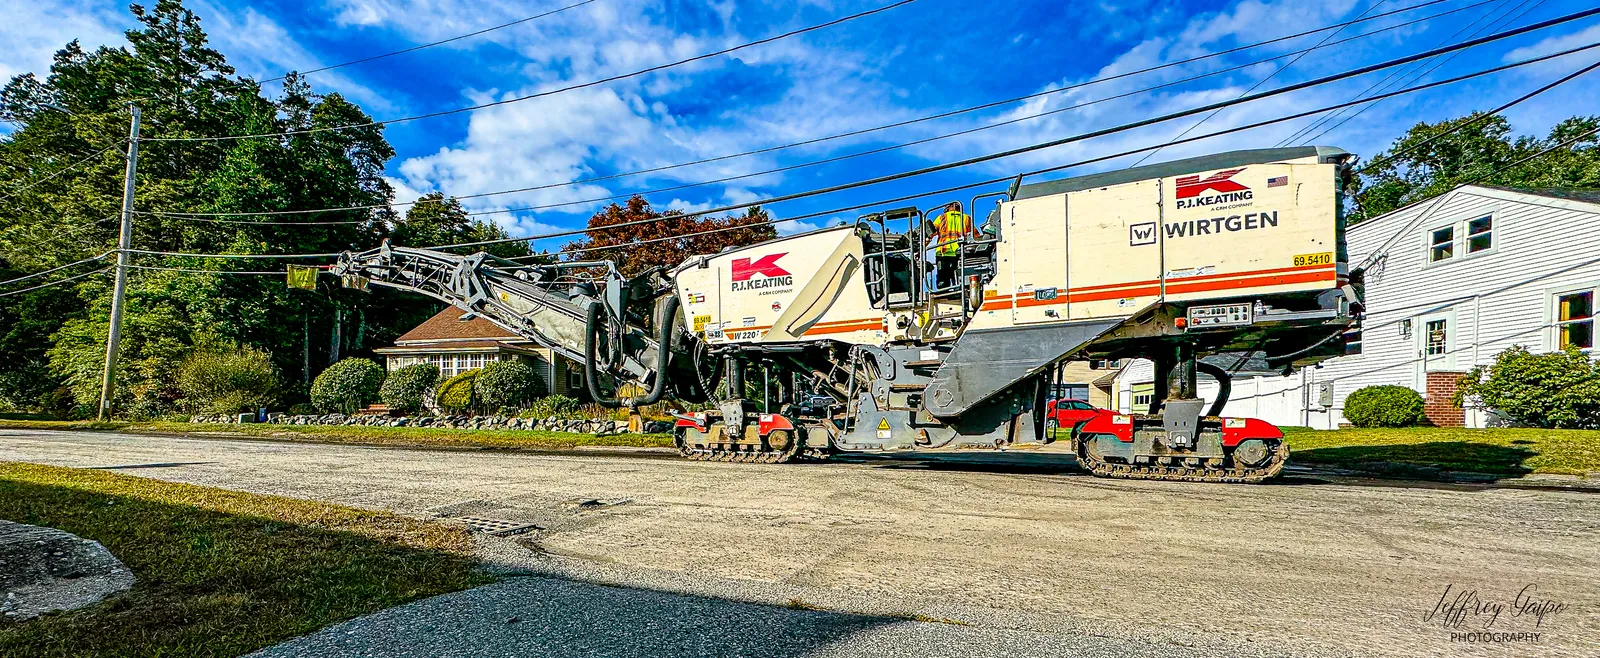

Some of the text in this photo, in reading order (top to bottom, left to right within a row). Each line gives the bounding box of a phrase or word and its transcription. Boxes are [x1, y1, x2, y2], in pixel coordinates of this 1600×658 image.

[1176, 191, 1253, 209] P.J.KEATING
[1228, 202, 1253, 210] COMPANY
[1164, 210, 1278, 239] WIRTGEN
[1293, 254, 1330, 267] 69.5410
[731, 276, 793, 292] P.J.KEATING
[734, 332, 742, 340] W
